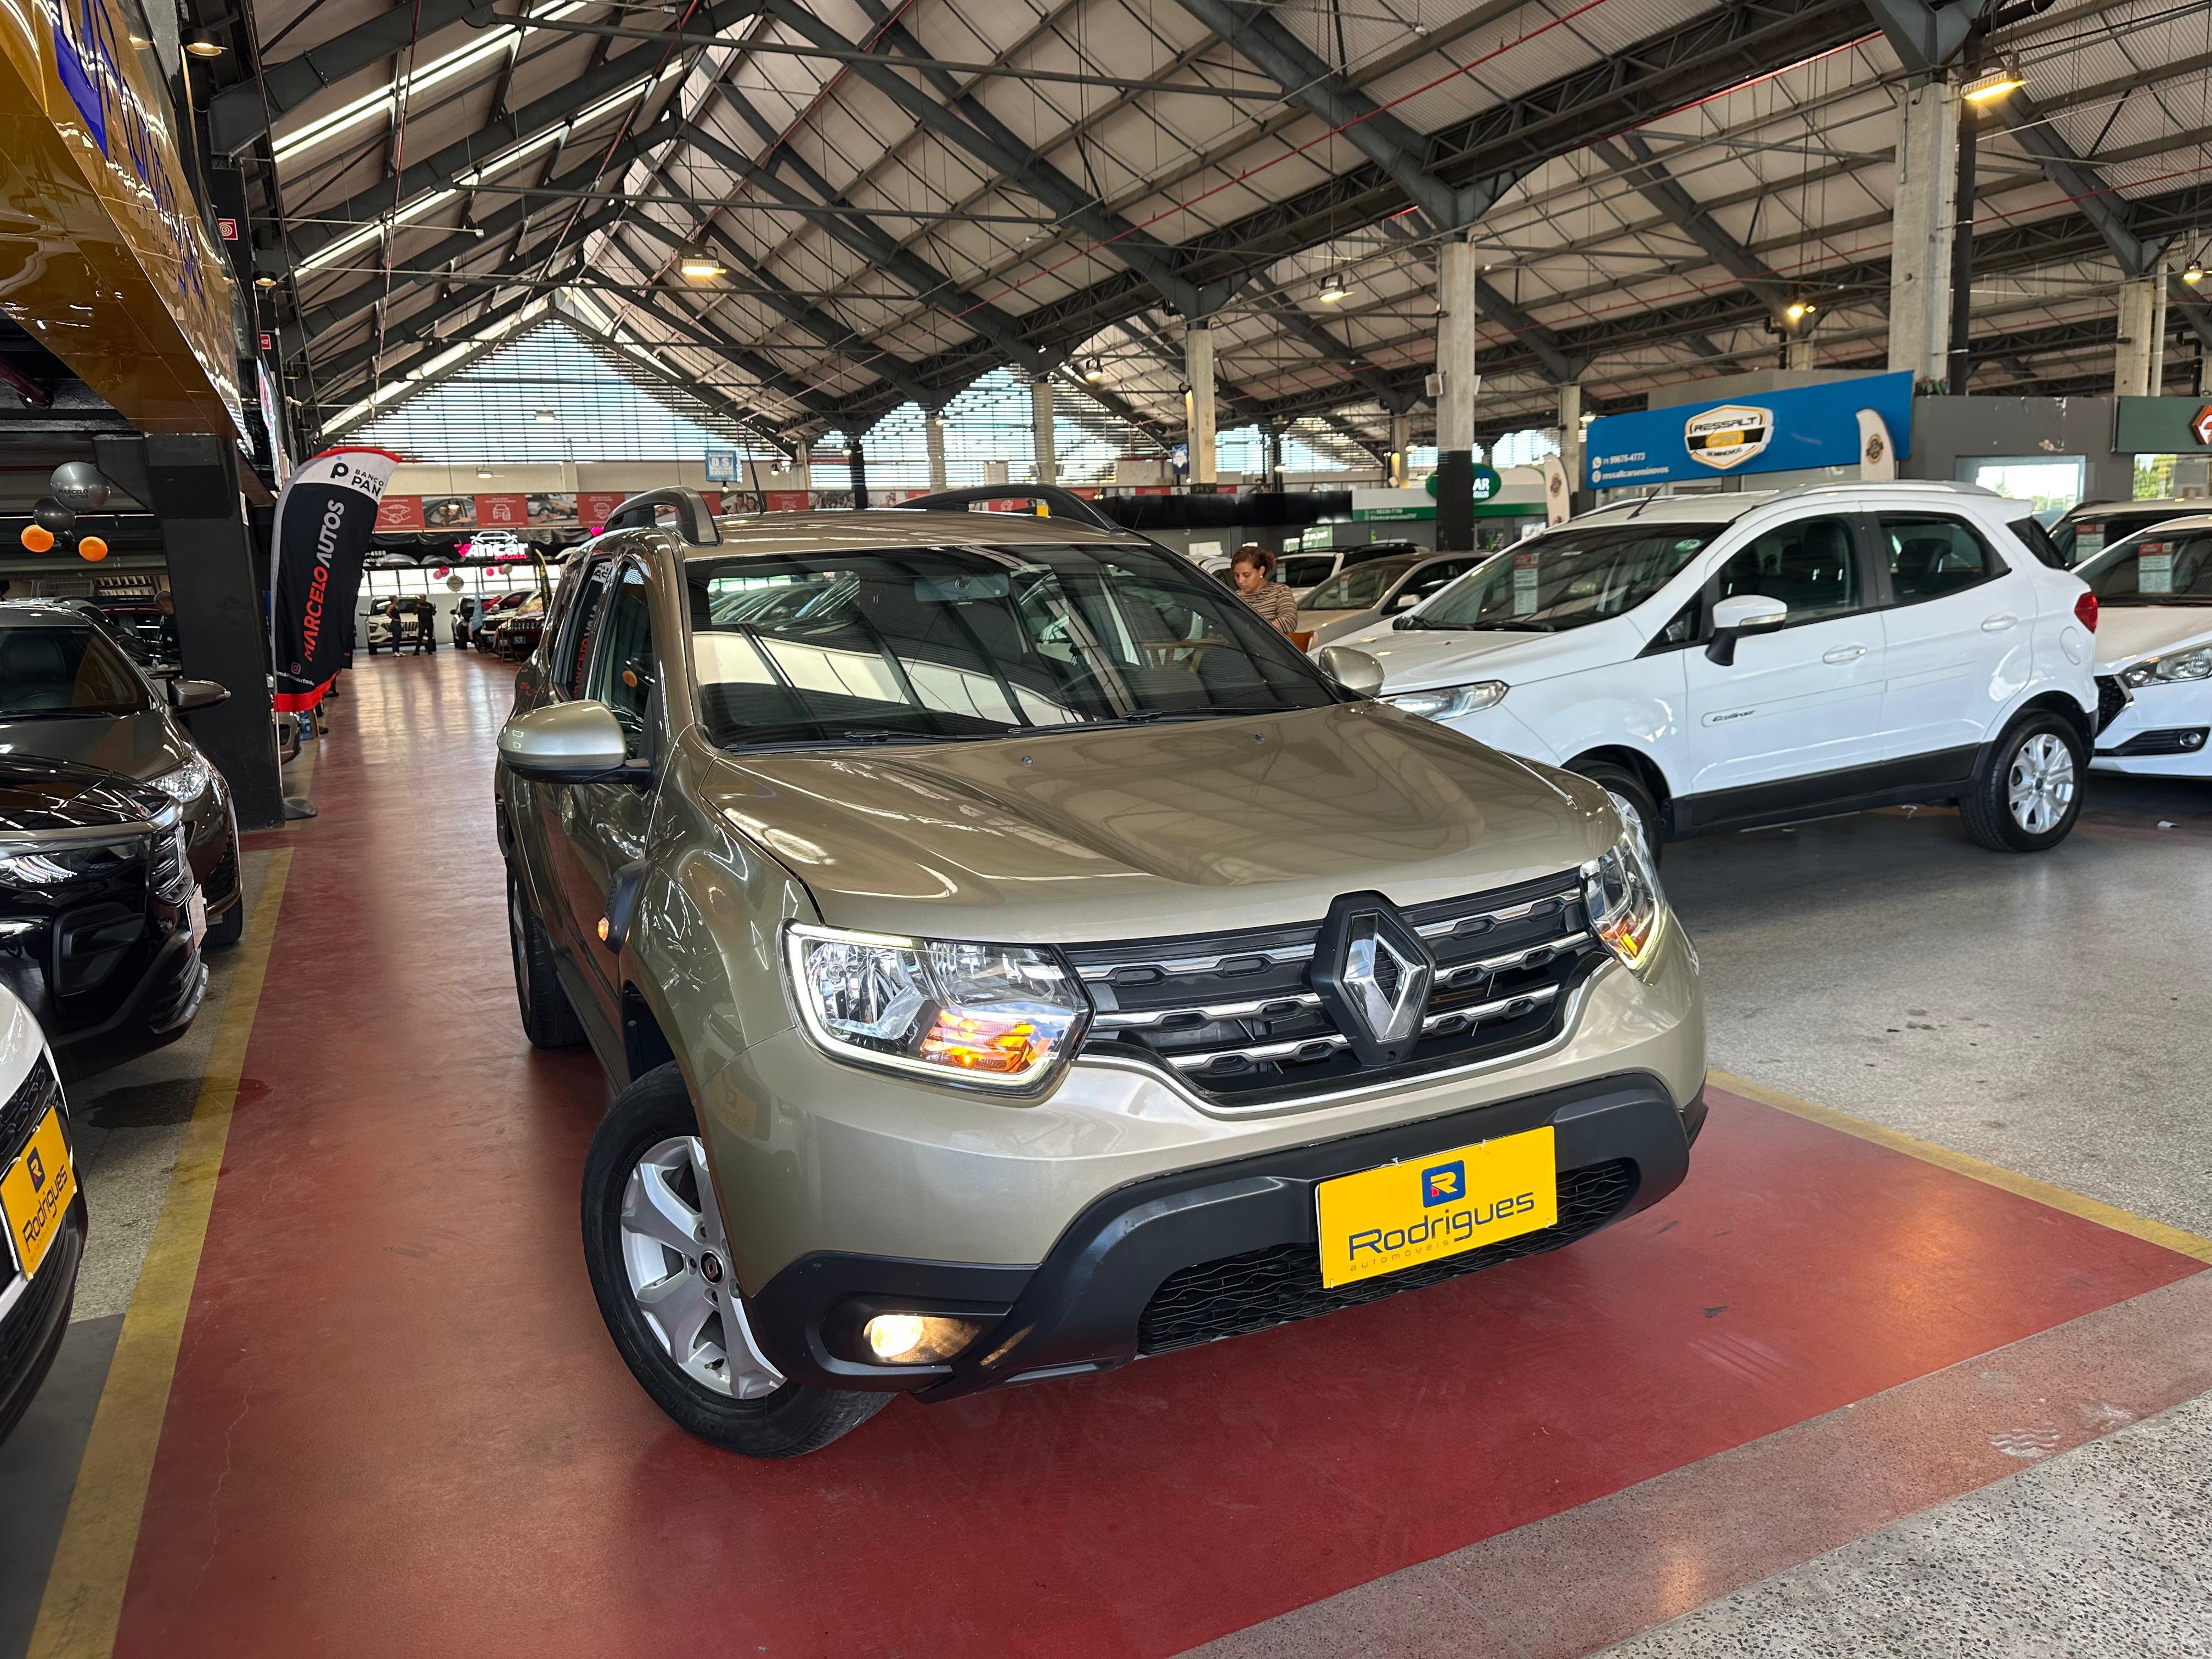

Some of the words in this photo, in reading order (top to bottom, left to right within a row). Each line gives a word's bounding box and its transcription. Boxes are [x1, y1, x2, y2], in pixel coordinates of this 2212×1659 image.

[1694, 417, 1757, 432] RESSALT
[351, 476, 381, 496] PAN
[355, 469, 384, 486] BANCO
[22, 1164, 68, 1253] Rodrigues
[1348, 1191, 1534, 1261] Rodrigues
[1350, 1239, 1449, 1272] automóveis
